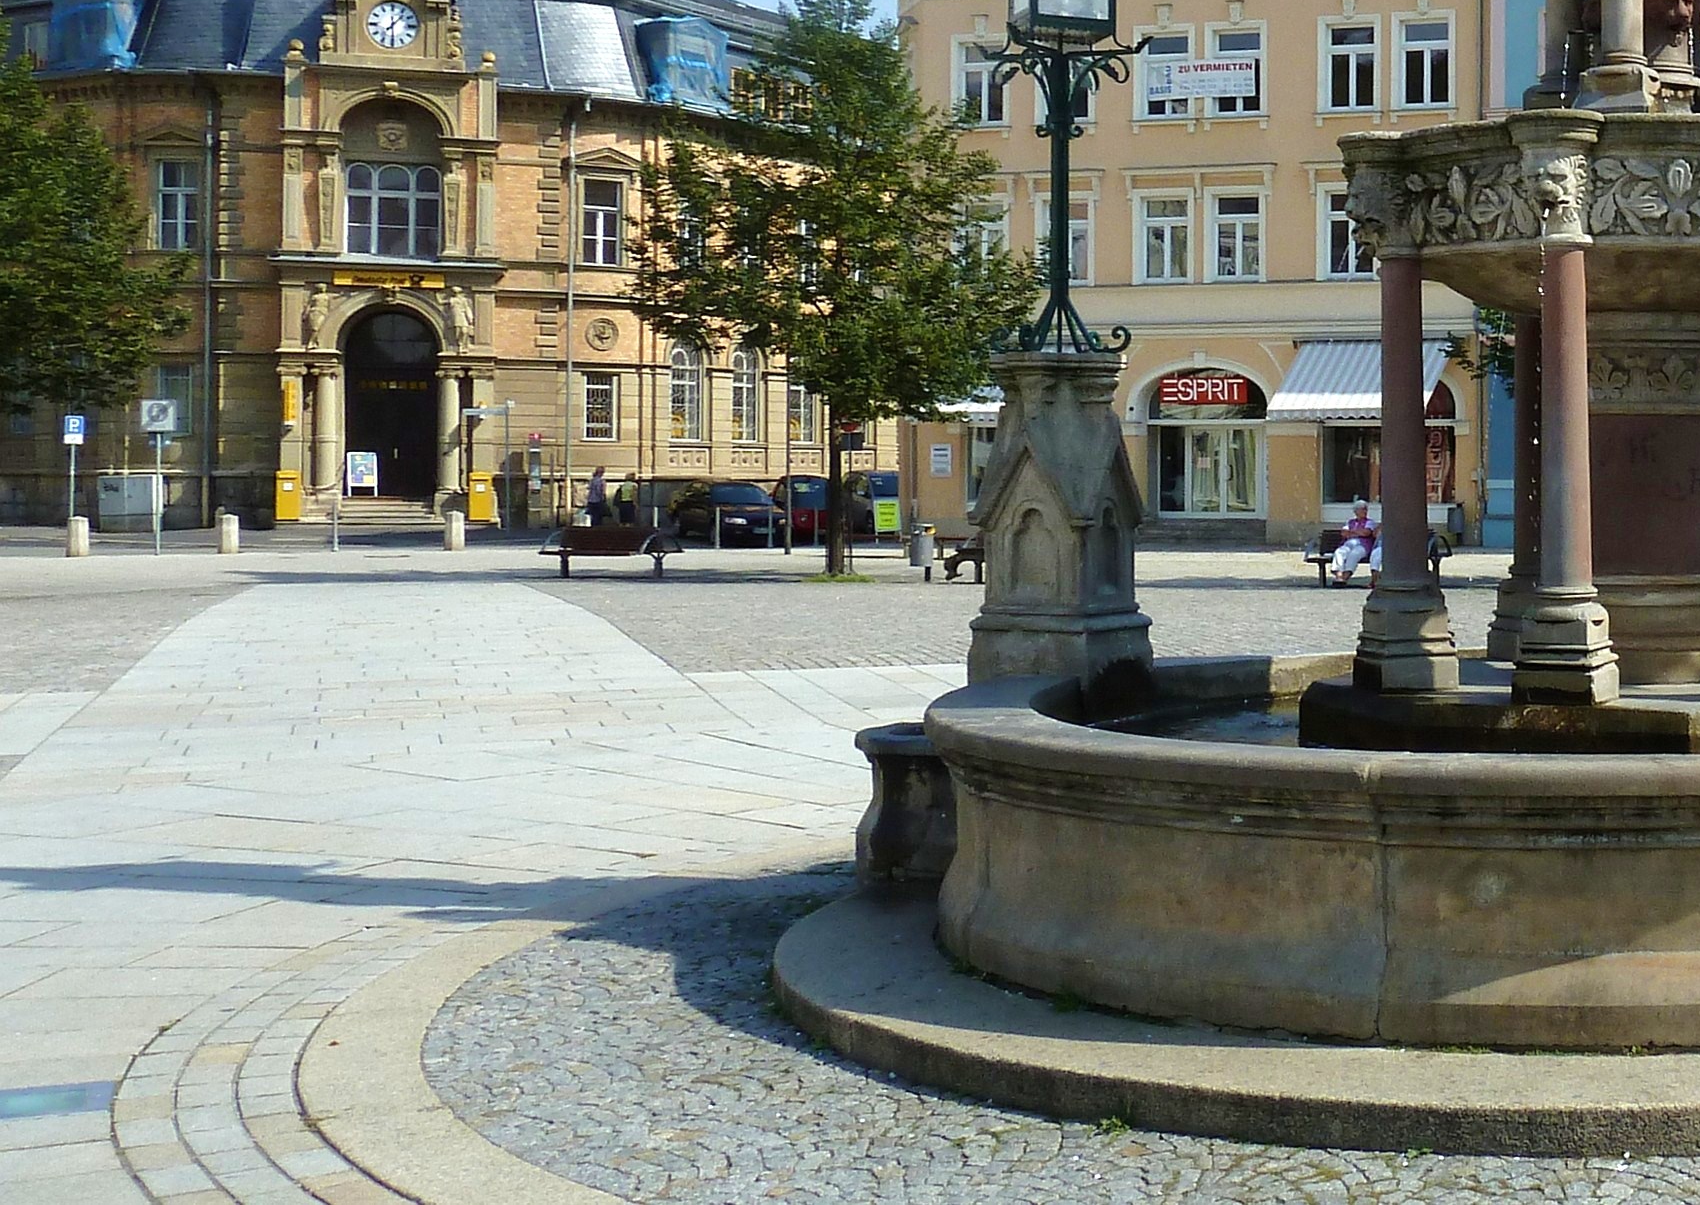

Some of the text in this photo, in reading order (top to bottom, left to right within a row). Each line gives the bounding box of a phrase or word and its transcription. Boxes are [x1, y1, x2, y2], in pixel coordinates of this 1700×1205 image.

[1178, 63, 1253, 73] ZU VERMIETEN
[1163, 379, 1244, 401] ESPRIT
[68, 418, 80, 432] P
